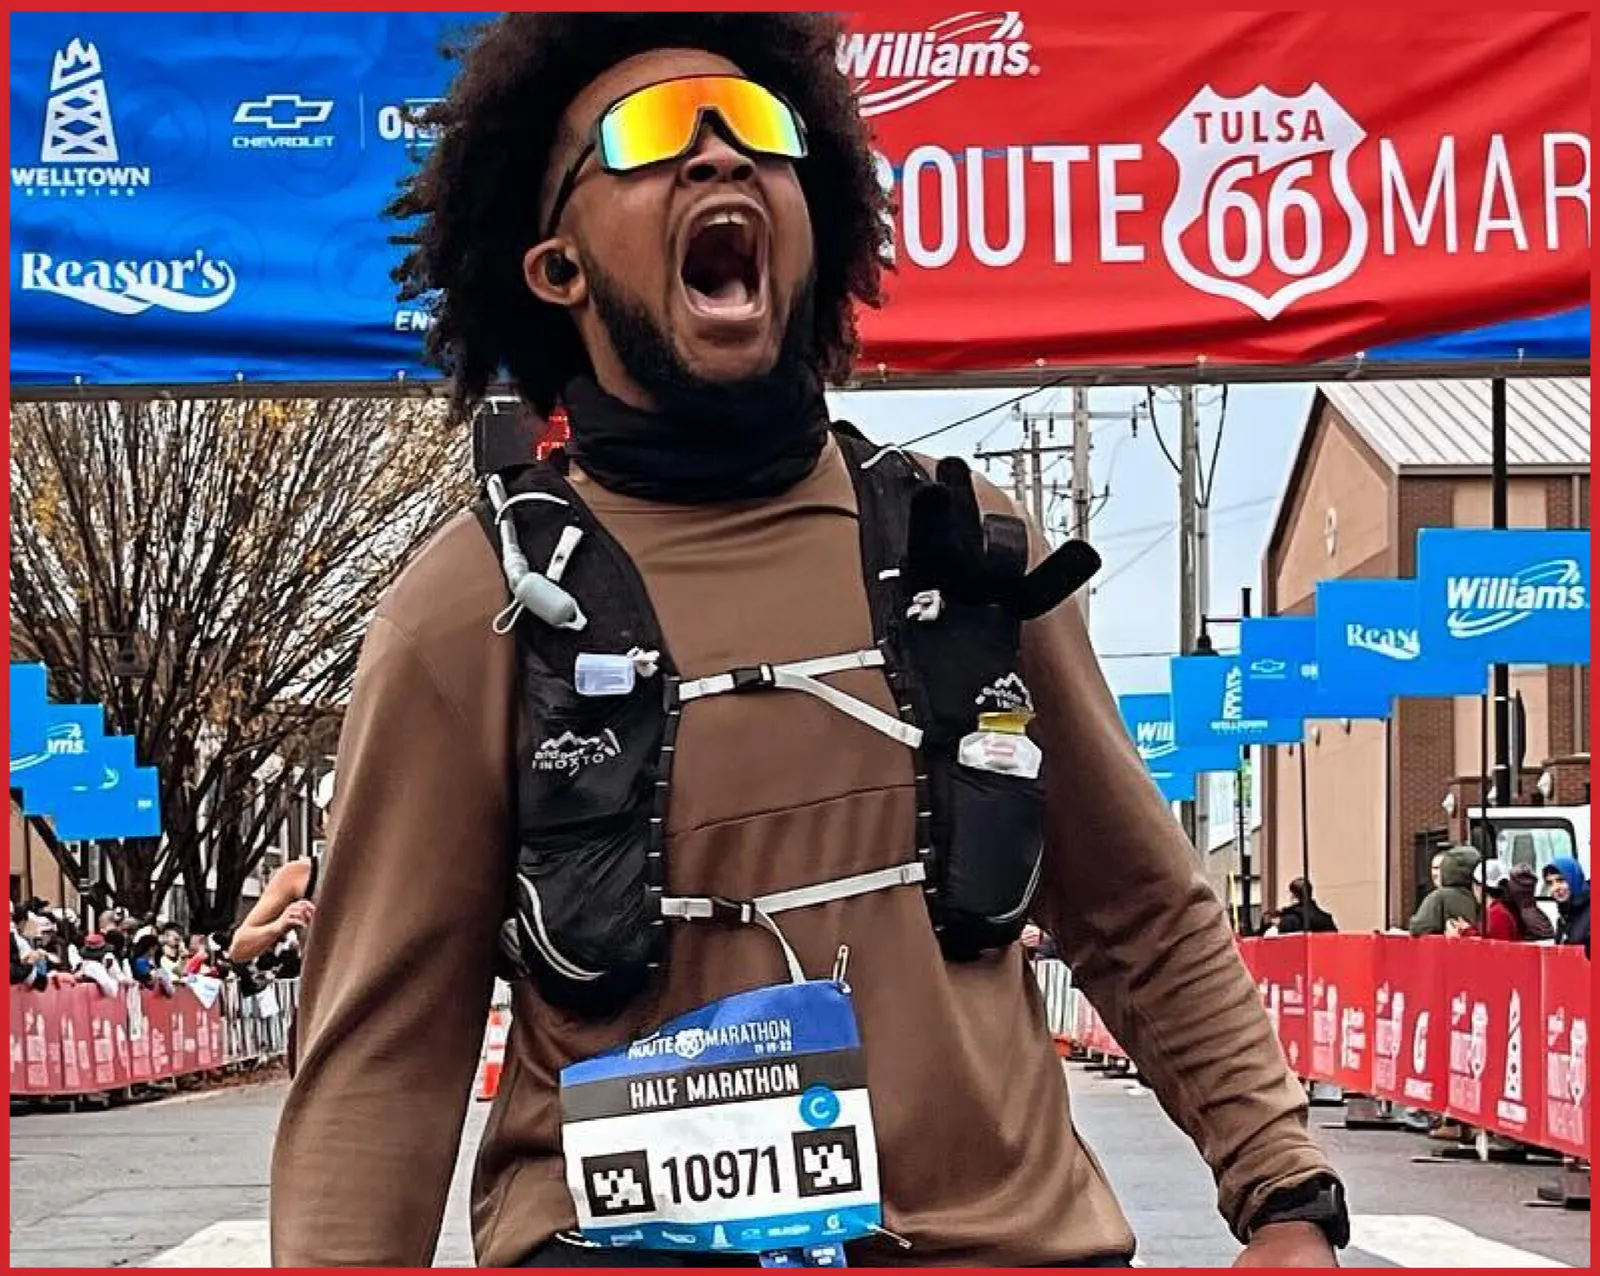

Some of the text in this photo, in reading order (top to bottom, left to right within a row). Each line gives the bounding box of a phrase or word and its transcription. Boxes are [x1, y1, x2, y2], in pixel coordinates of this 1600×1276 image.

[232, 136, 335, 148] CHEVROLET
[1194, 109, 1325, 143] TULSA
[11, 167, 150, 186] WELLTOWN
[1206, 157, 1323, 277] 66
[1379, 132, 1590, 255] MAR
[22, 249, 235, 309] Reasor's
[1447, 576, 1586, 609] Williams
[705, 1019, 792, 1047] MARATHON
[630, 1062, 800, 1109] HALF MARATHON
[809, 1097, 831, 1118] C
[661, 1145, 781, 1205] 10971
